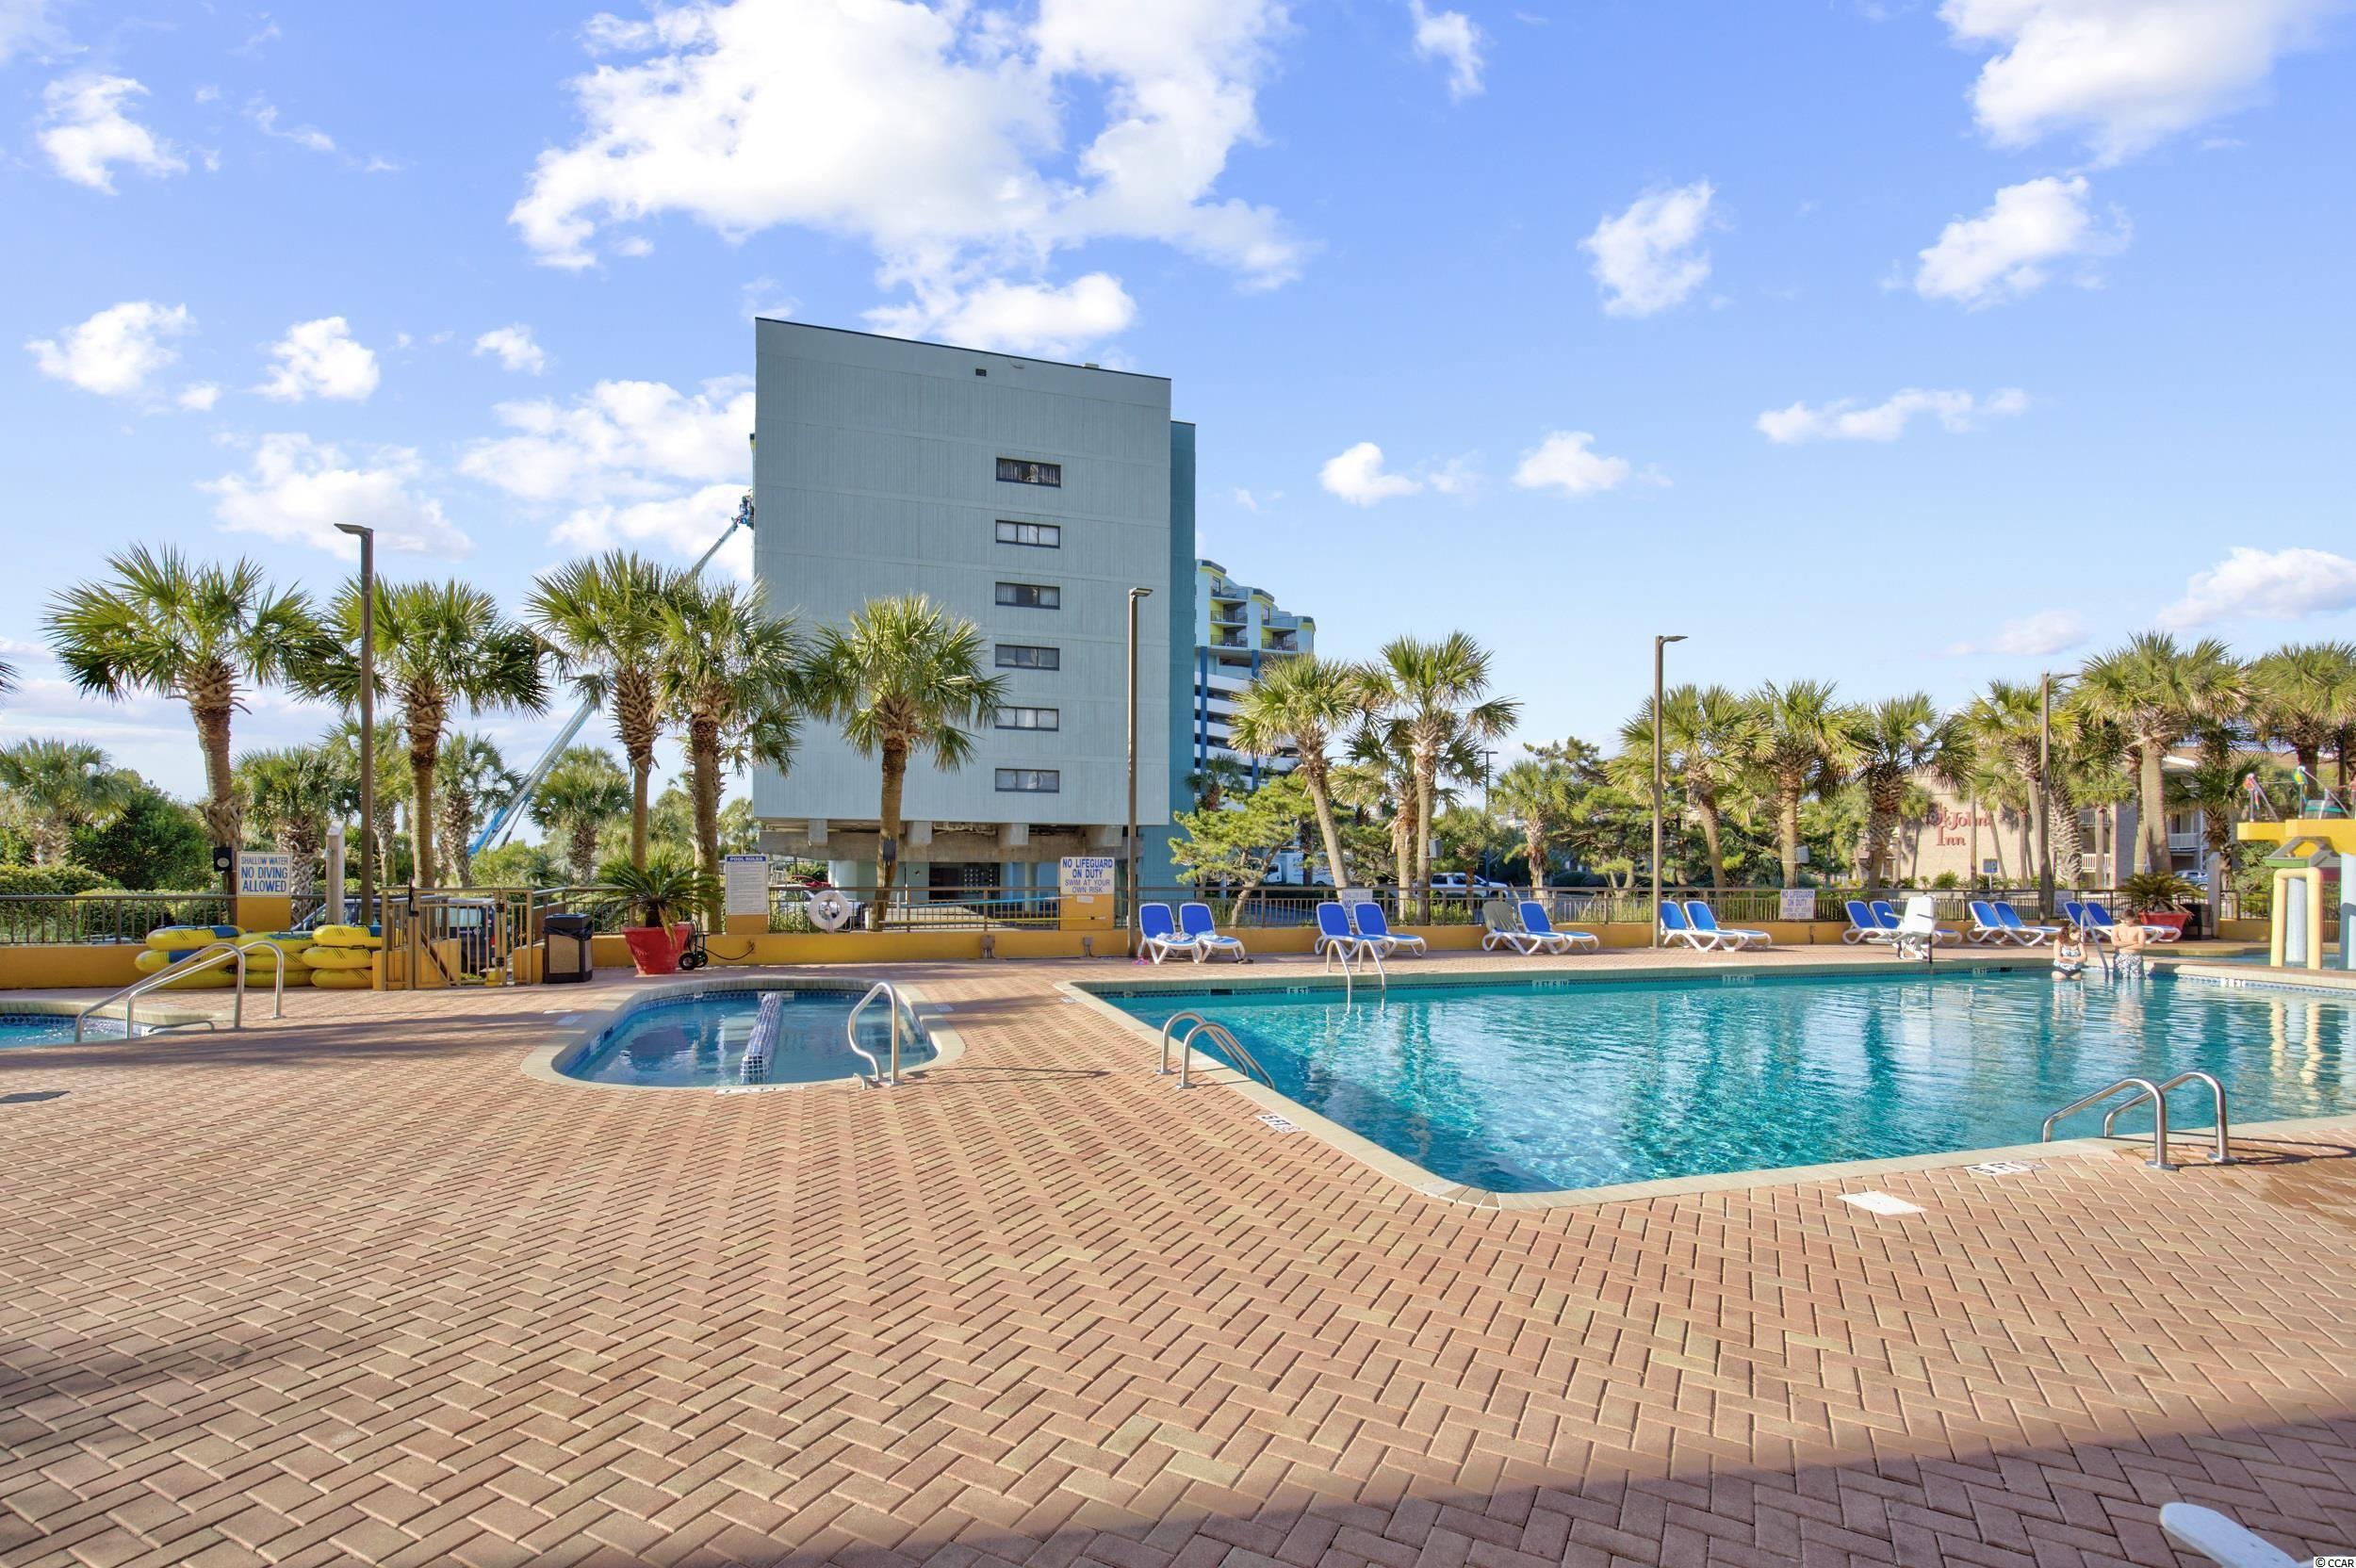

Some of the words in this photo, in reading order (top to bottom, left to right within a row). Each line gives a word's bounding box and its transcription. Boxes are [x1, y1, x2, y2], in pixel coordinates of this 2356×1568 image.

[1937, 825, 1966, 846] Inn
[241, 857, 268, 865] SHALLOW
[270, 857, 288, 865] WATER
[1062, 858, 1072, 868] NO
[1075, 858, 1113, 868] LIFEGUARD
[241, 866, 254, 879] NO
[257, 866, 288, 879] DIVING
[1072, 869, 1082, 878] ON
[1085, 869, 1104, 878] DUTY
[242, 880, 287, 892] ALLOWED
